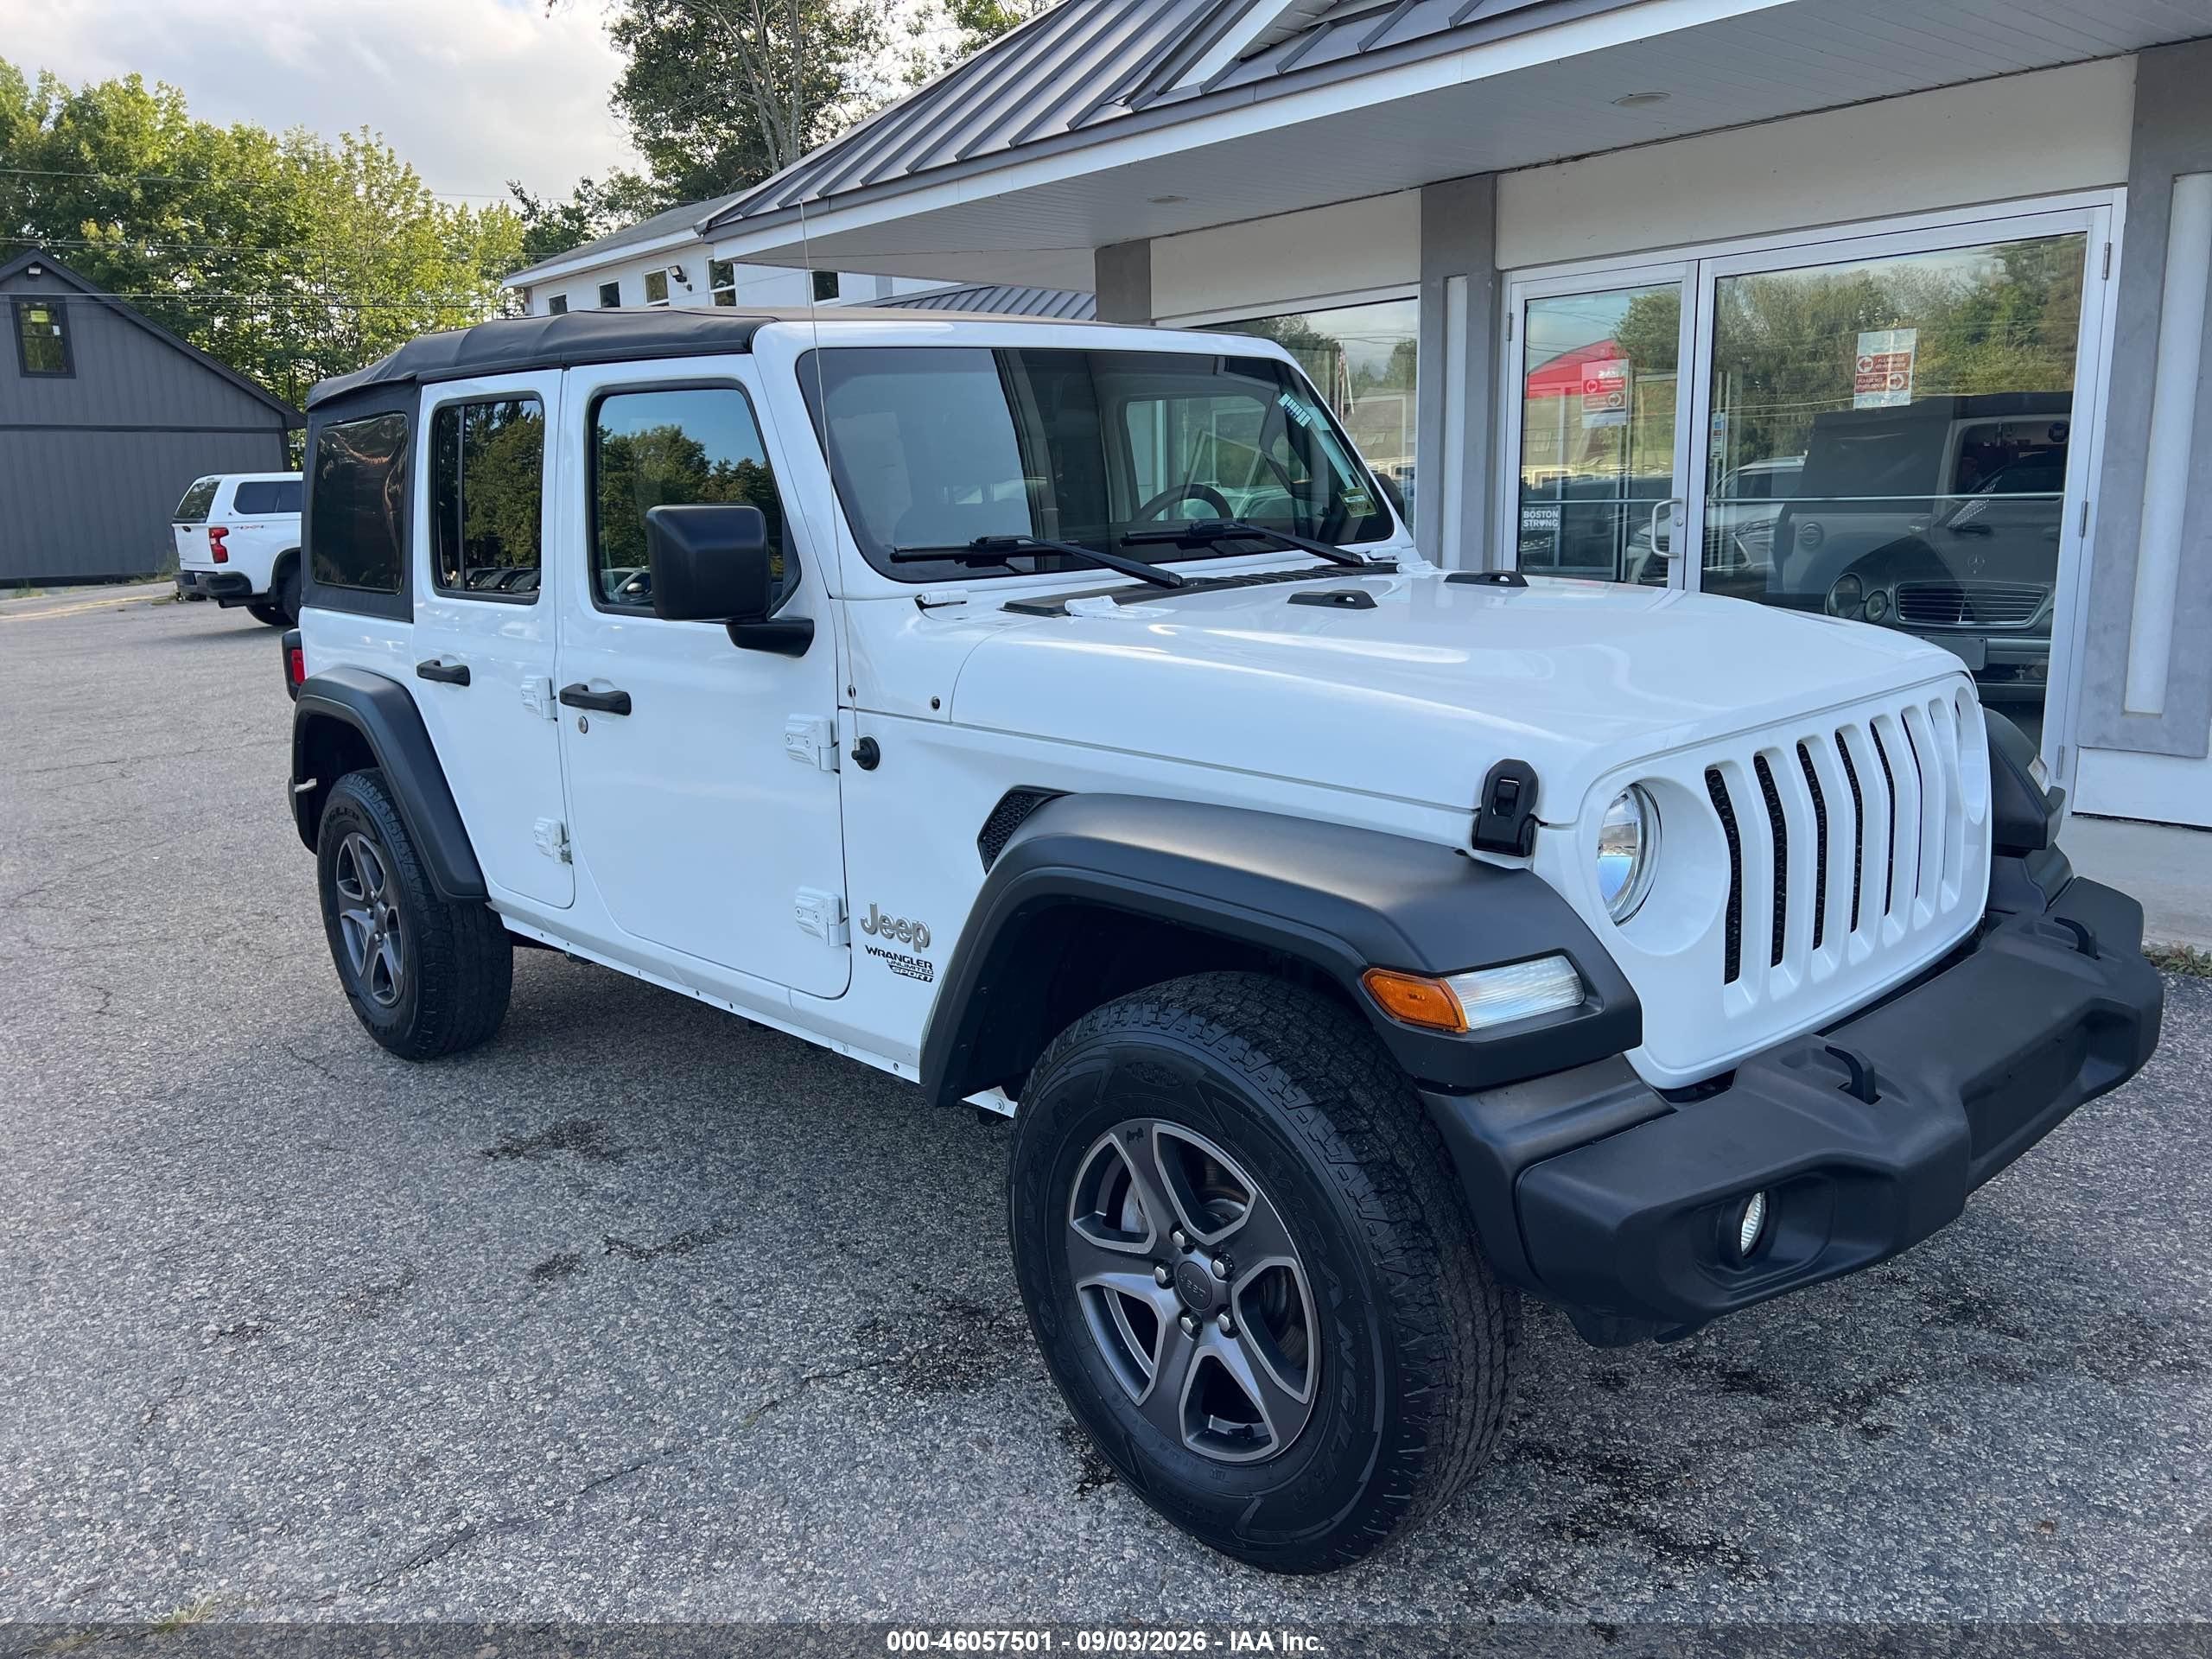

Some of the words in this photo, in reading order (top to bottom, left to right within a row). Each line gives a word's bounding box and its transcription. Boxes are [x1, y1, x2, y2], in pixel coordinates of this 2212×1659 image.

[860, 903, 931, 954] Jeep
[865, 944, 933, 970] WRANGLER
[887, 959, 934, 975] UNLIMITED
[892, 966, 934, 982] SPORT
